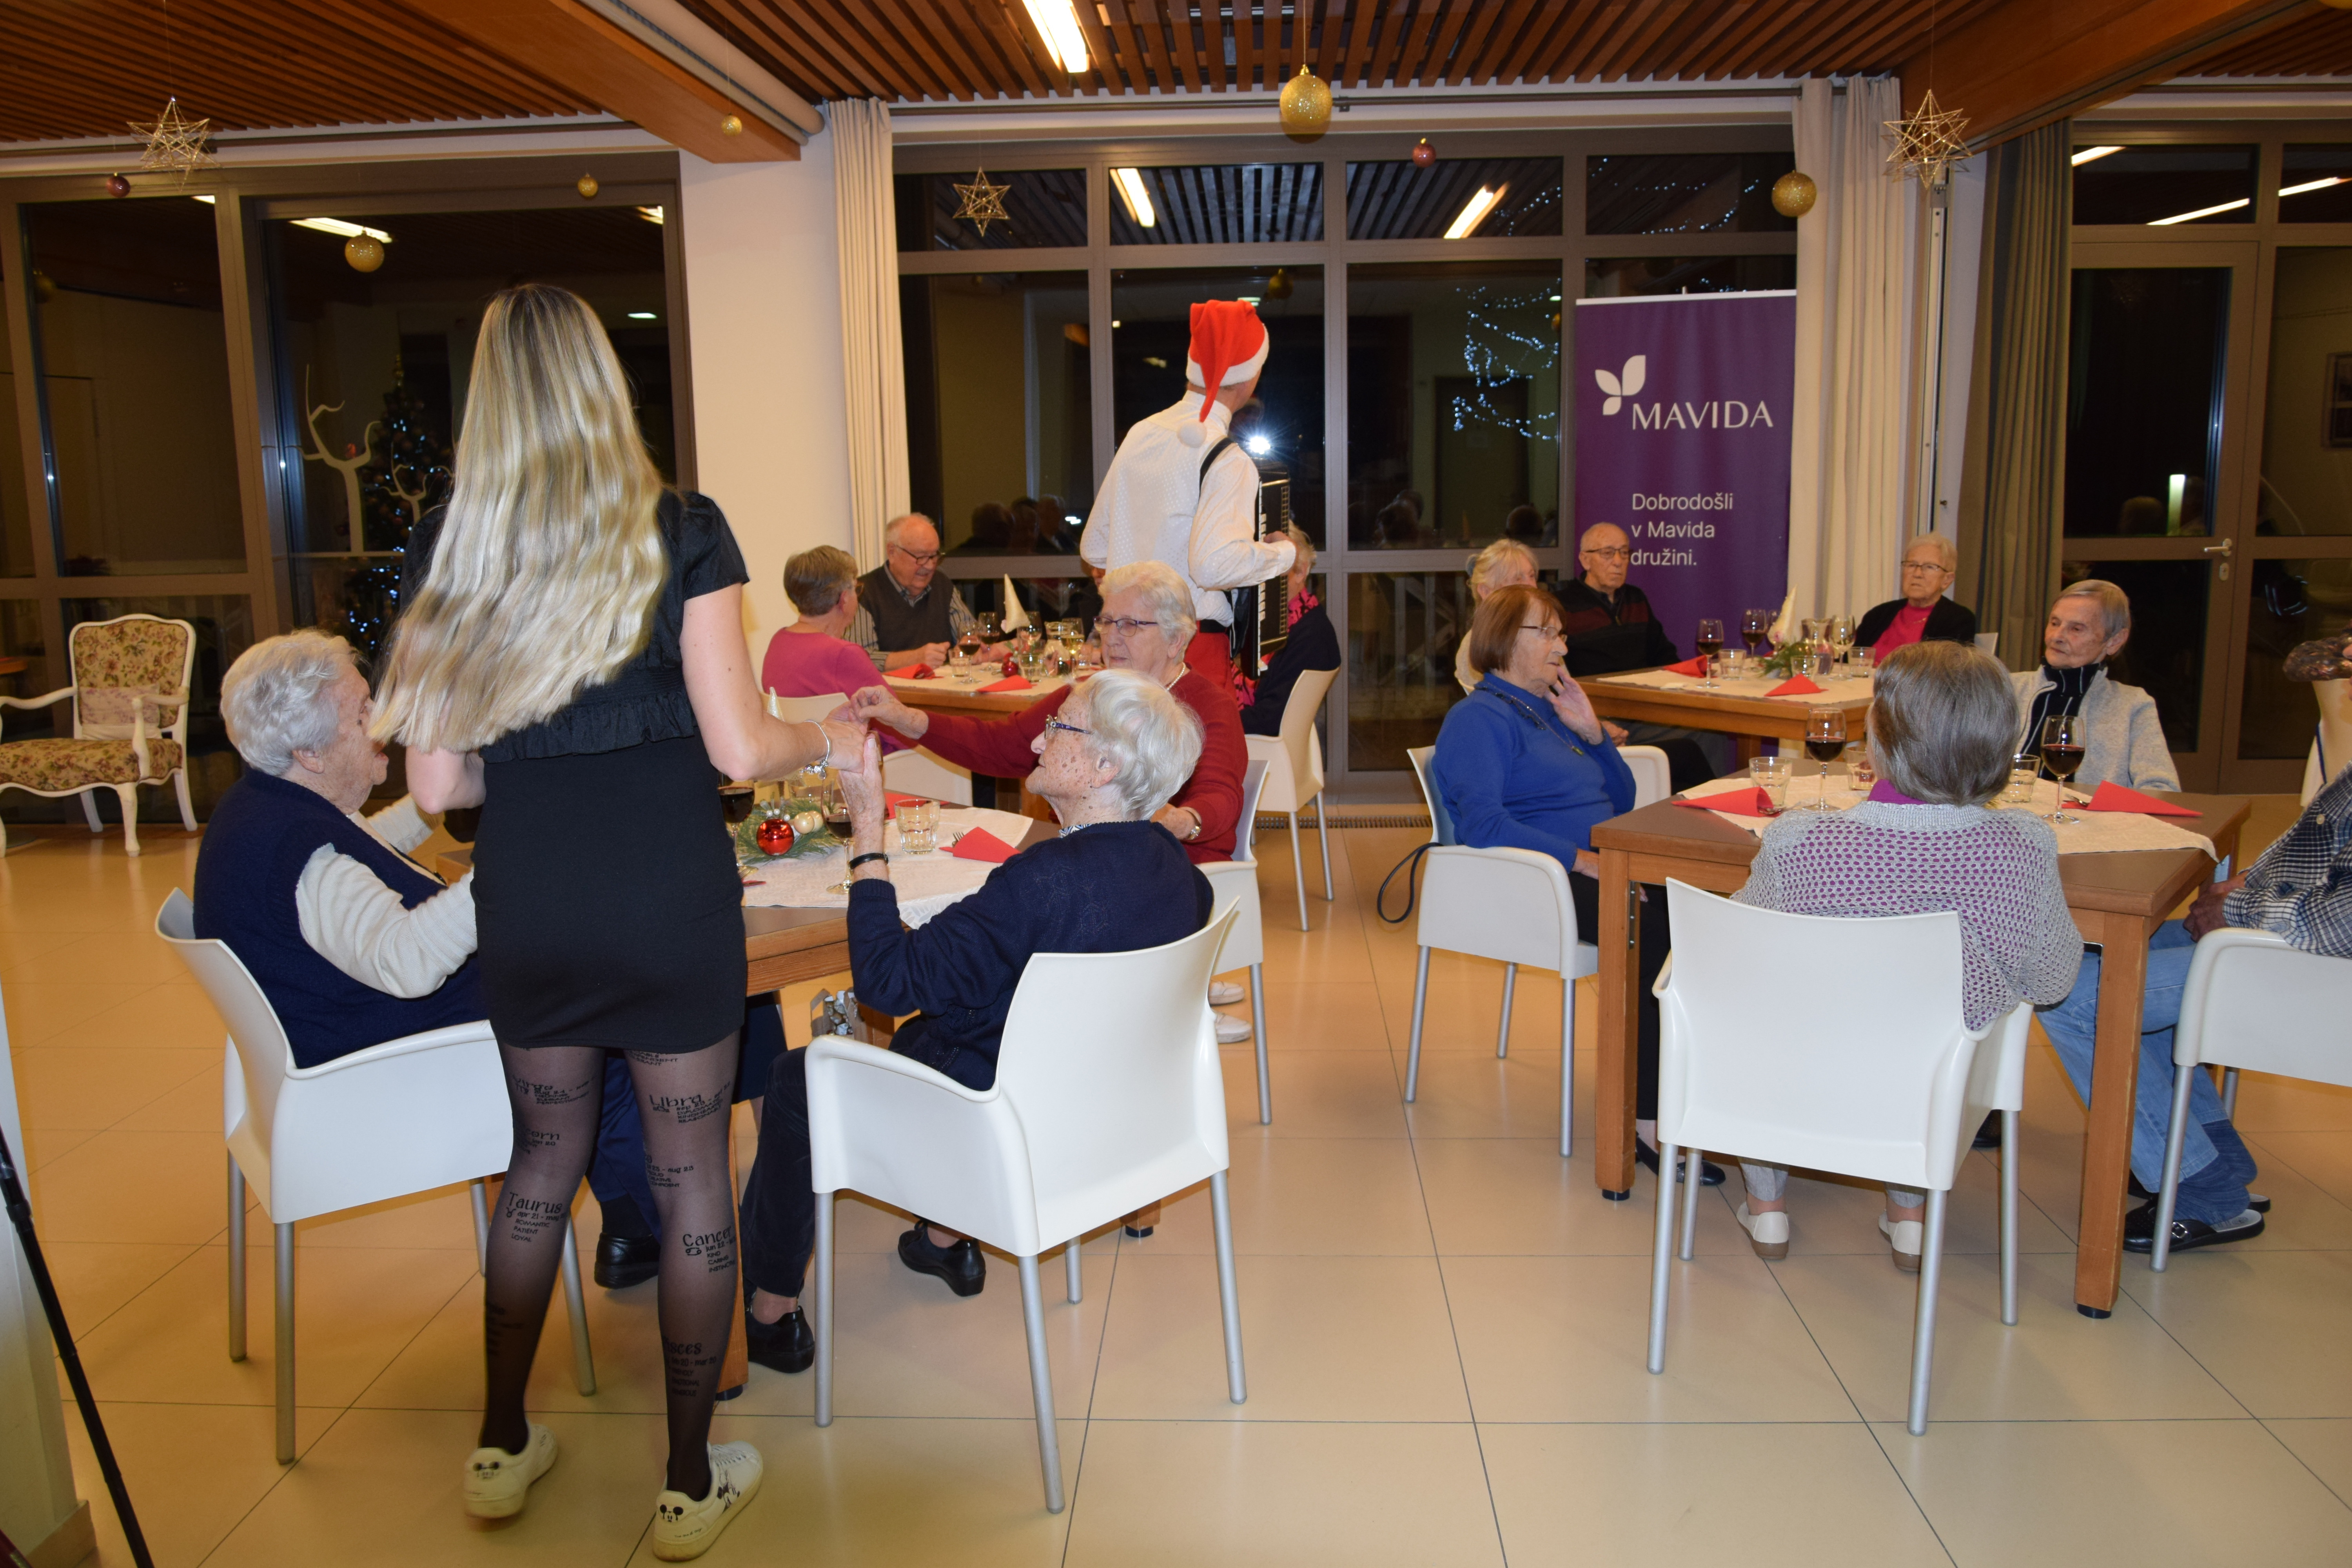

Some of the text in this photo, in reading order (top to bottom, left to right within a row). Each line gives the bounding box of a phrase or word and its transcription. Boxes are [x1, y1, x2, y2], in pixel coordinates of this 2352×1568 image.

[1632, 400, 1773, 430] MAVIDA
[1632, 492, 1733, 510] Dobrodošli
[1631, 521, 1715, 538] v Mavida
[1630, 549, 1697, 566] družini.
[649, 1094, 702, 1107] Libra
[509, 1192, 563, 1214] Taurus
[513, 1226, 539, 1234] PATIENT
[515, 1218, 550, 1228] ROMANTIC
[511, 1233, 532, 1242] LOYAL
[682, 1225, 731, 1247] Cancer
[708, 1255, 730, 1265] CARING
